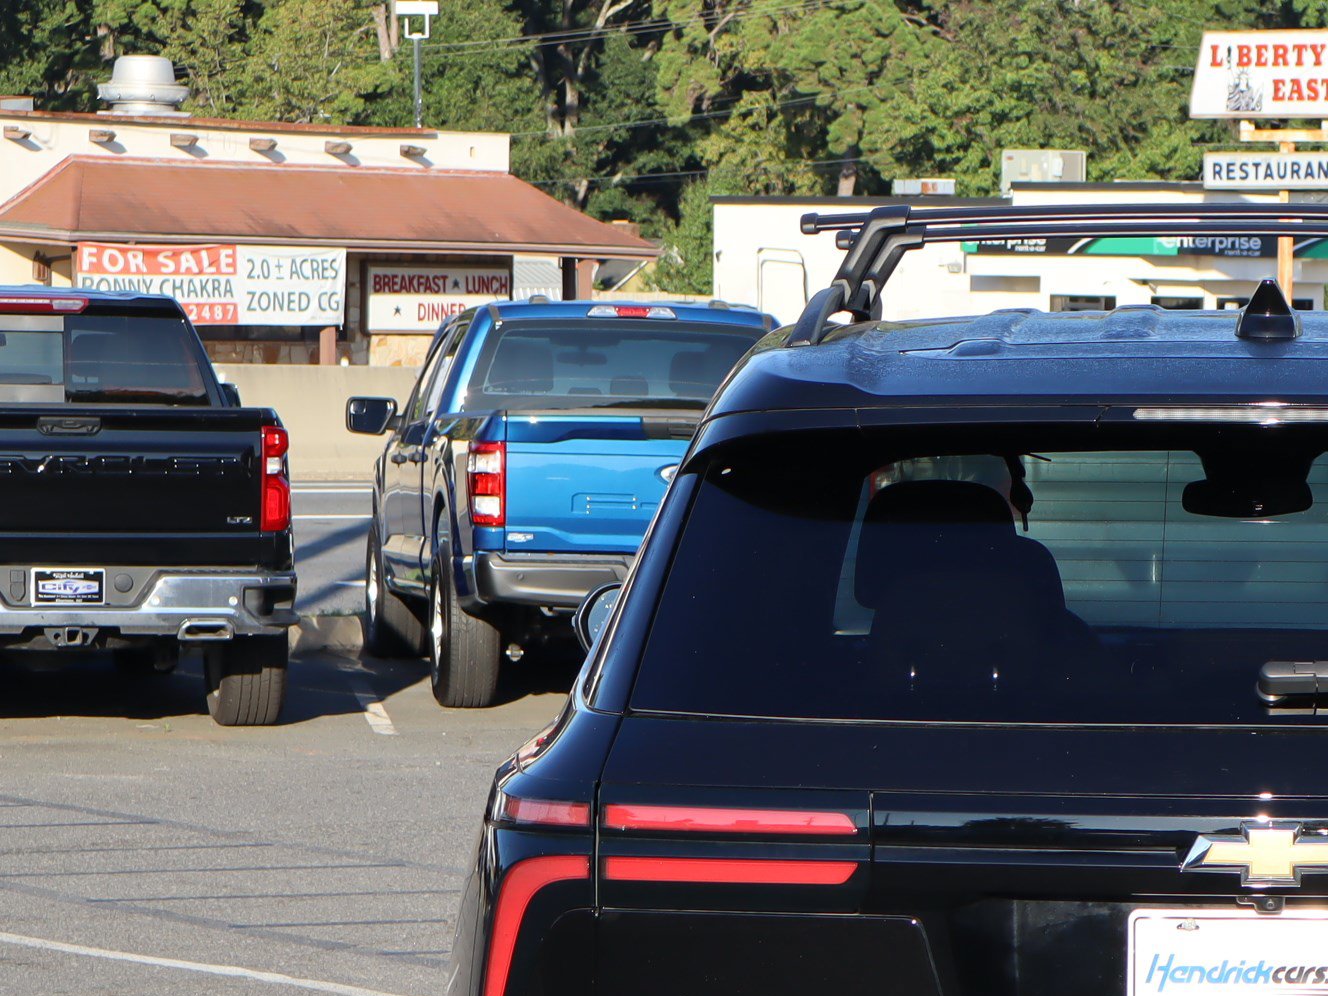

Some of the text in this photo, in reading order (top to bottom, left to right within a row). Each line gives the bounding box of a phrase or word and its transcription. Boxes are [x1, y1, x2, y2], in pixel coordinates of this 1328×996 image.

[81, 247, 235, 274] FOR SALE
[246, 258, 270, 280] 2.0
[289, 258, 338, 280] ACRES
[159, 277, 234, 299] CHAKRA
[373, 274, 508, 293] BREAKFAST LUNCH
[246, 291, 340, 312] ZONED CG
[226, 516, 253, 524] LTZ
